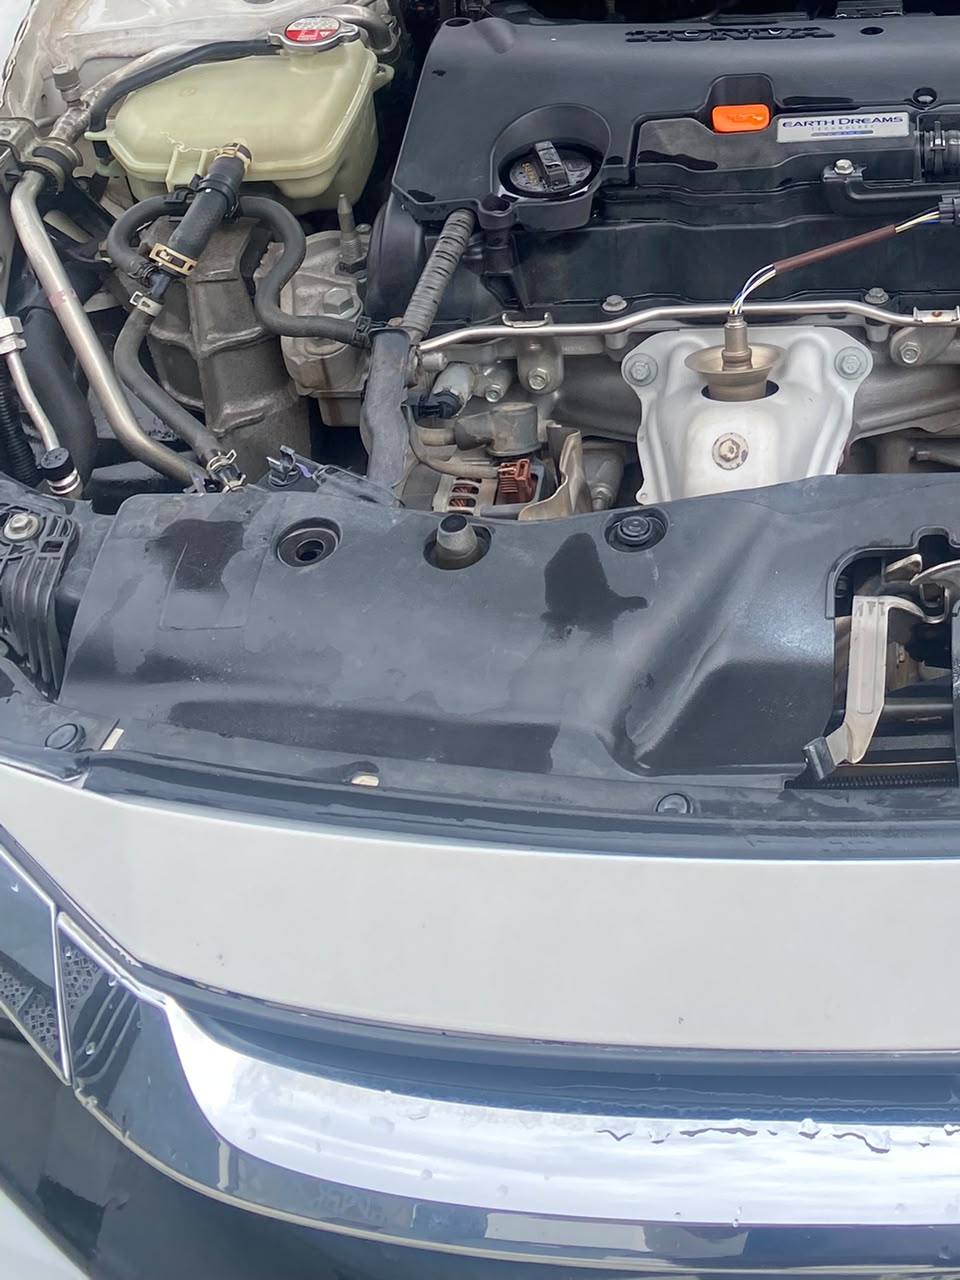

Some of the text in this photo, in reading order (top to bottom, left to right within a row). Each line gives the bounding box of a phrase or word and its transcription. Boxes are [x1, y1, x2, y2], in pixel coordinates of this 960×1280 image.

[625, 26, 836, 42] HONDA
[782, 116, 904, 128] EARTH DREAMS
